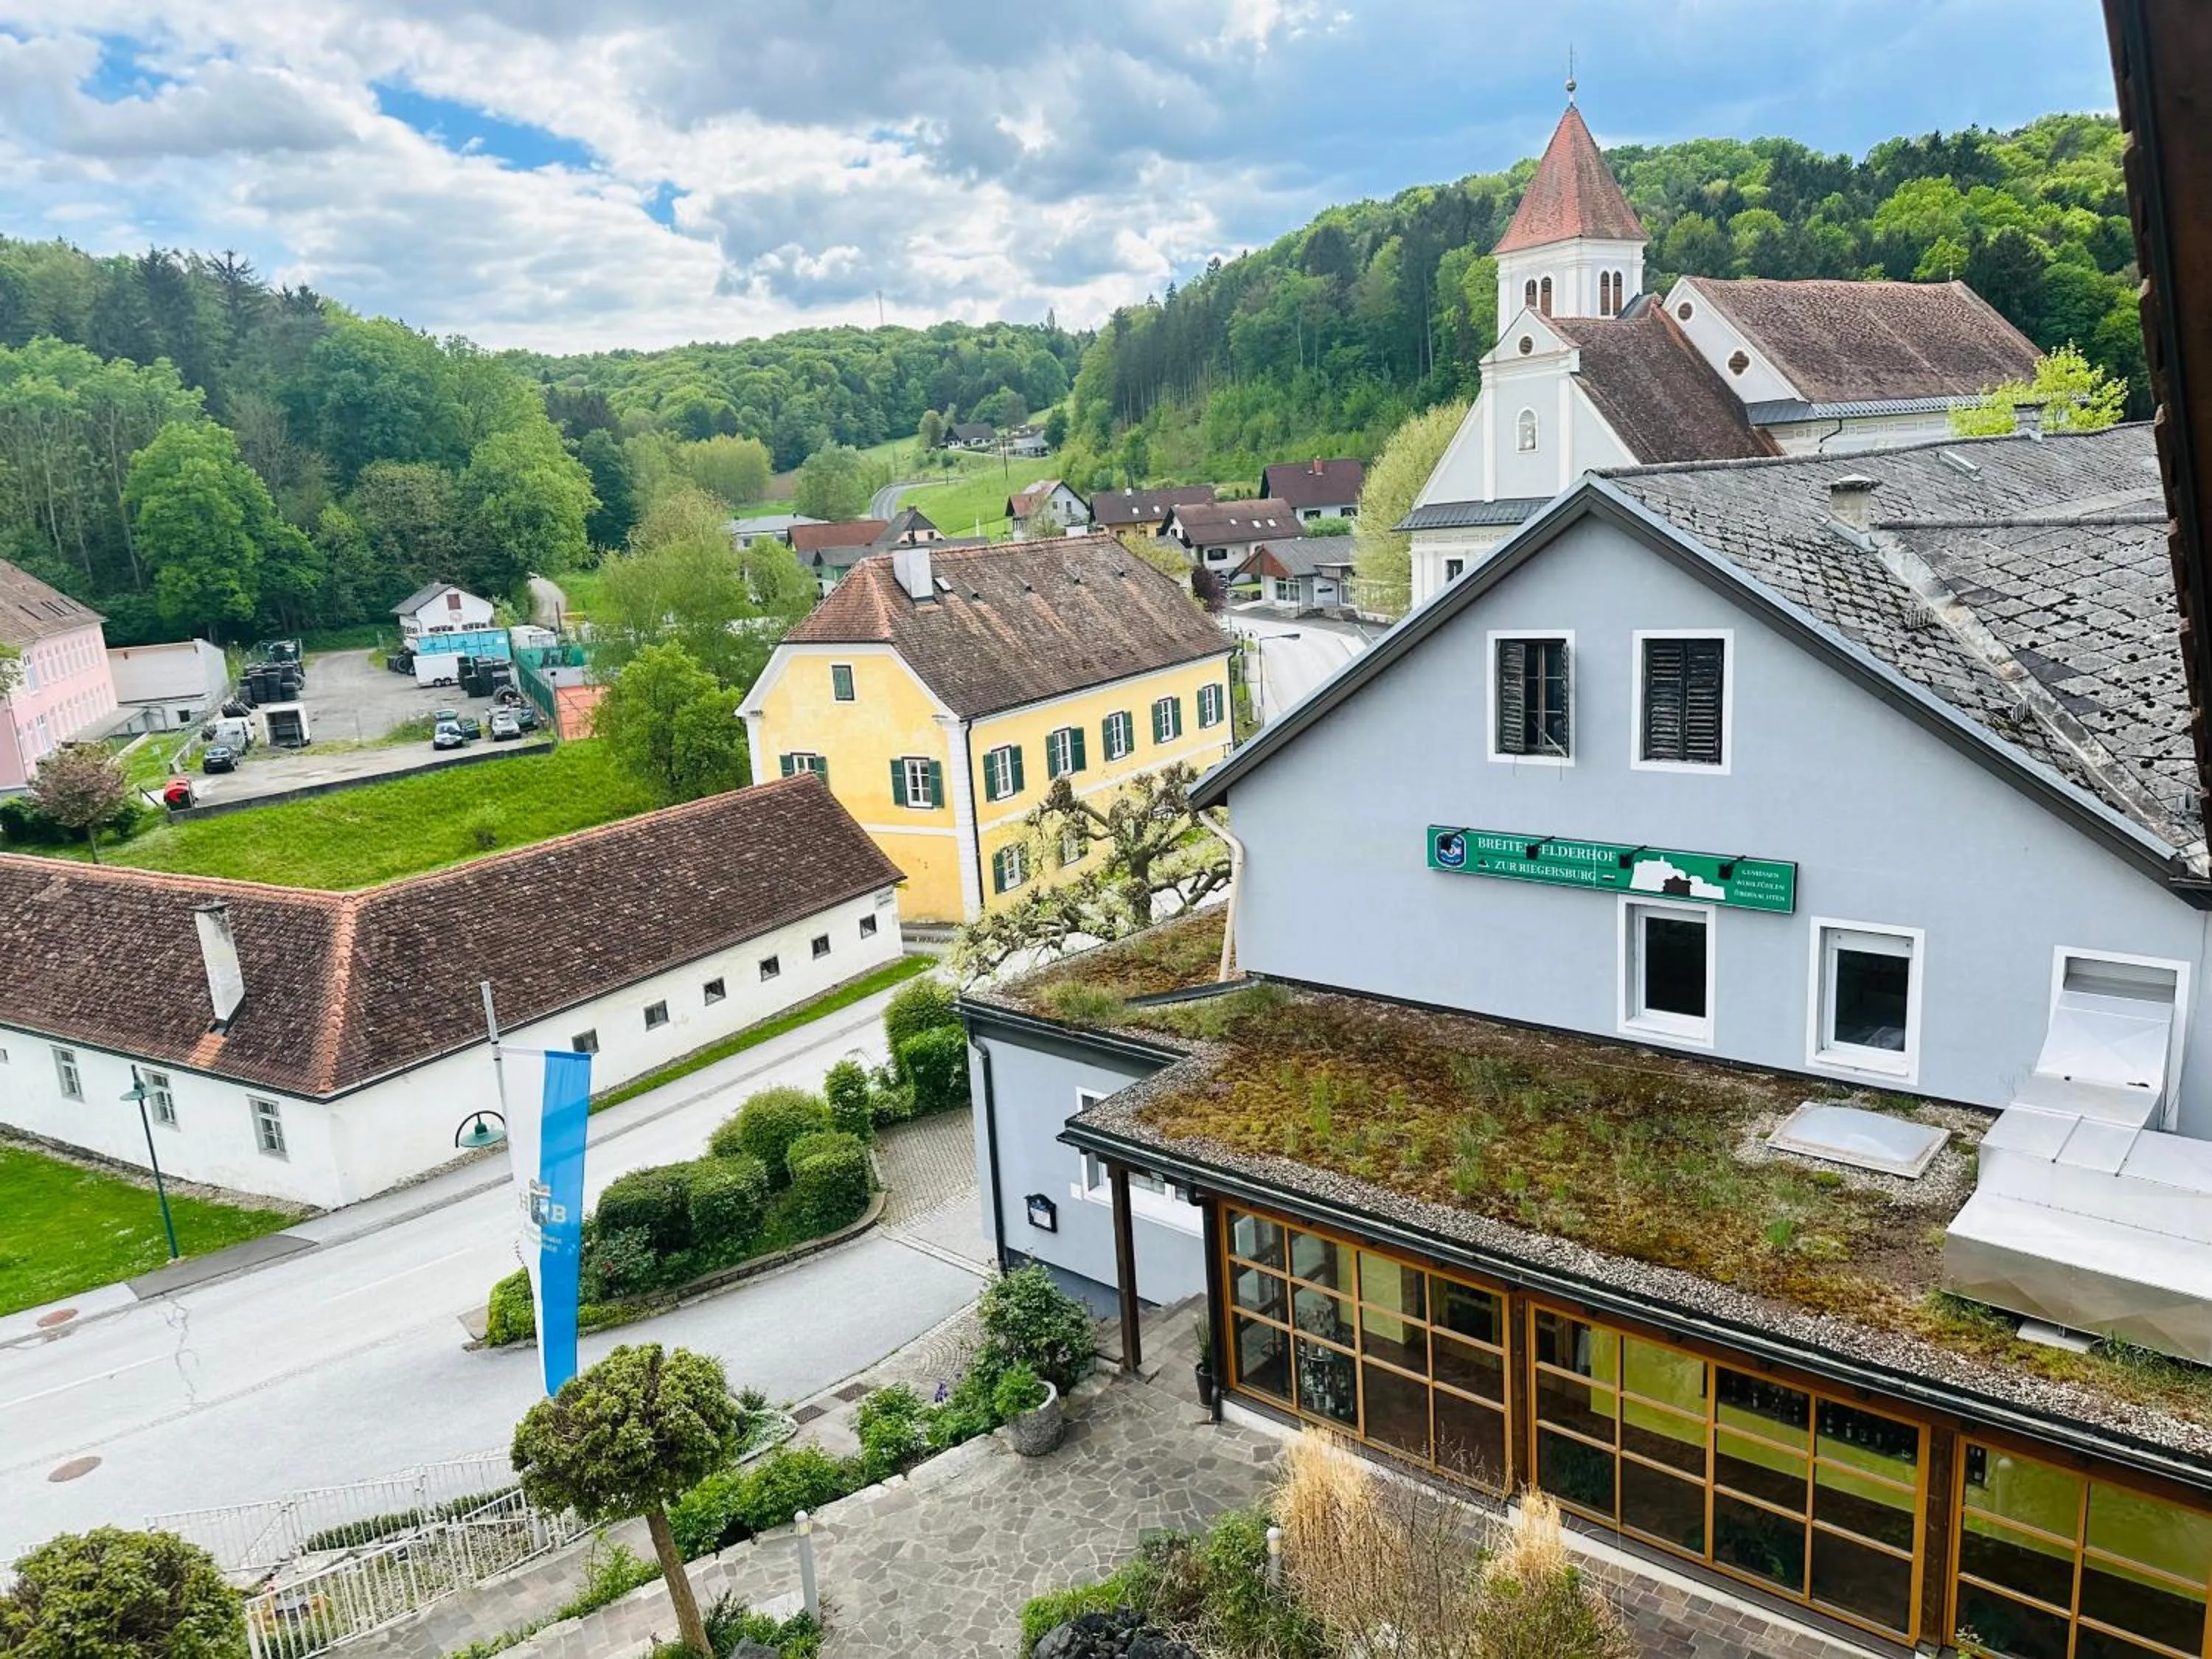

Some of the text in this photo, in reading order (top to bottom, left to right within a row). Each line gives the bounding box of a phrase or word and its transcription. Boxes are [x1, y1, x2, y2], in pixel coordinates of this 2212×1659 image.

[1478, 837, 1616, 862] BREITEELDERHOF
[1495, 860, 1595, 881] ZUR RIEGERSBURG
